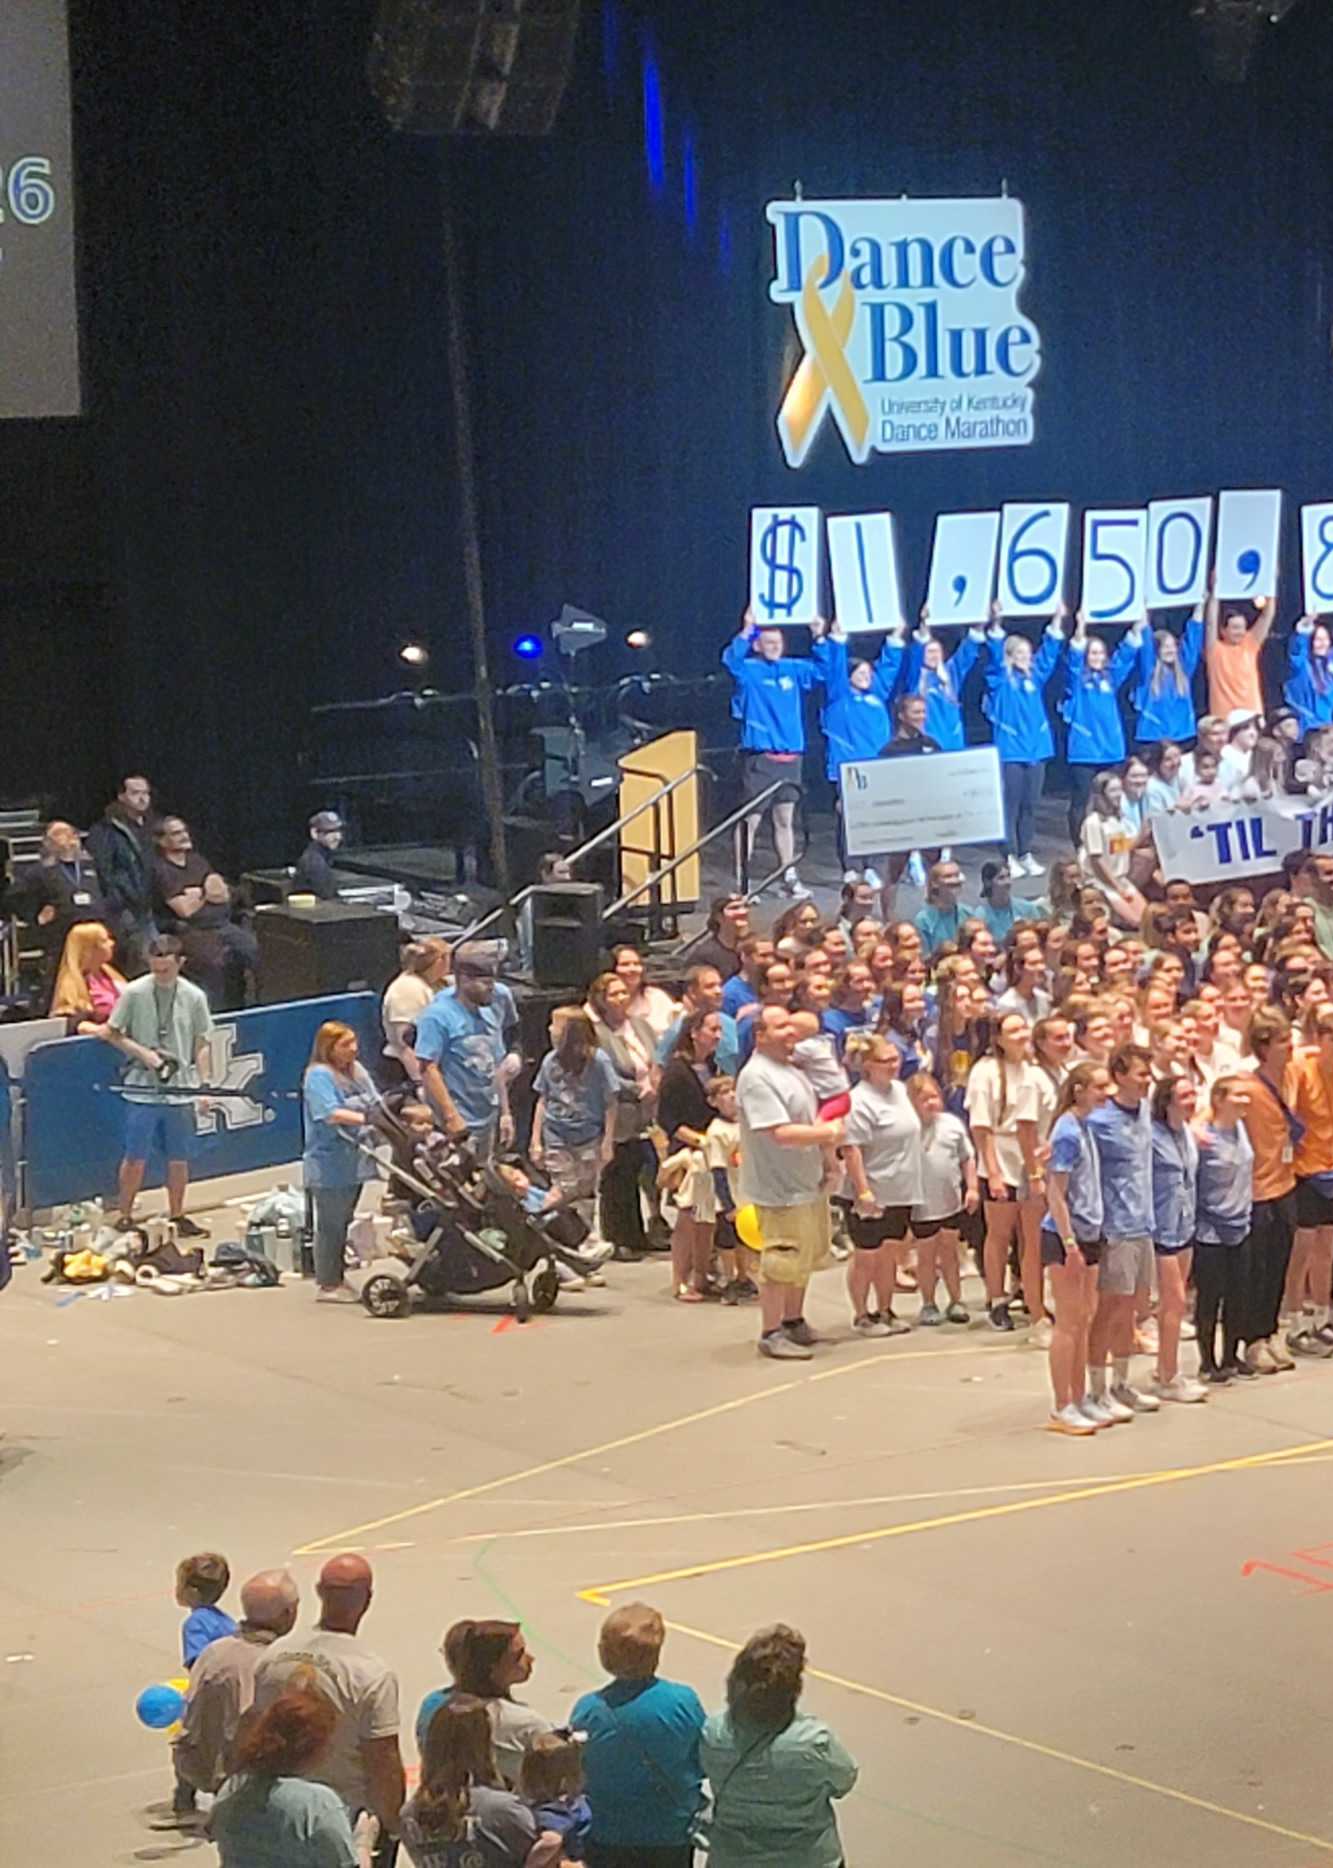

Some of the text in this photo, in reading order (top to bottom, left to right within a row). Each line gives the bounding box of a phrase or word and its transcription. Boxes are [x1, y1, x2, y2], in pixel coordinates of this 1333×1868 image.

[0, 157, 55, 224] 6
[775, 210, 1019, 293] Dance
[862, 300, 1034, 384] Blue
[881, 392, 1028, 416] University of Kentucky
[881, 416, 1028, 443] Dance Marathon
